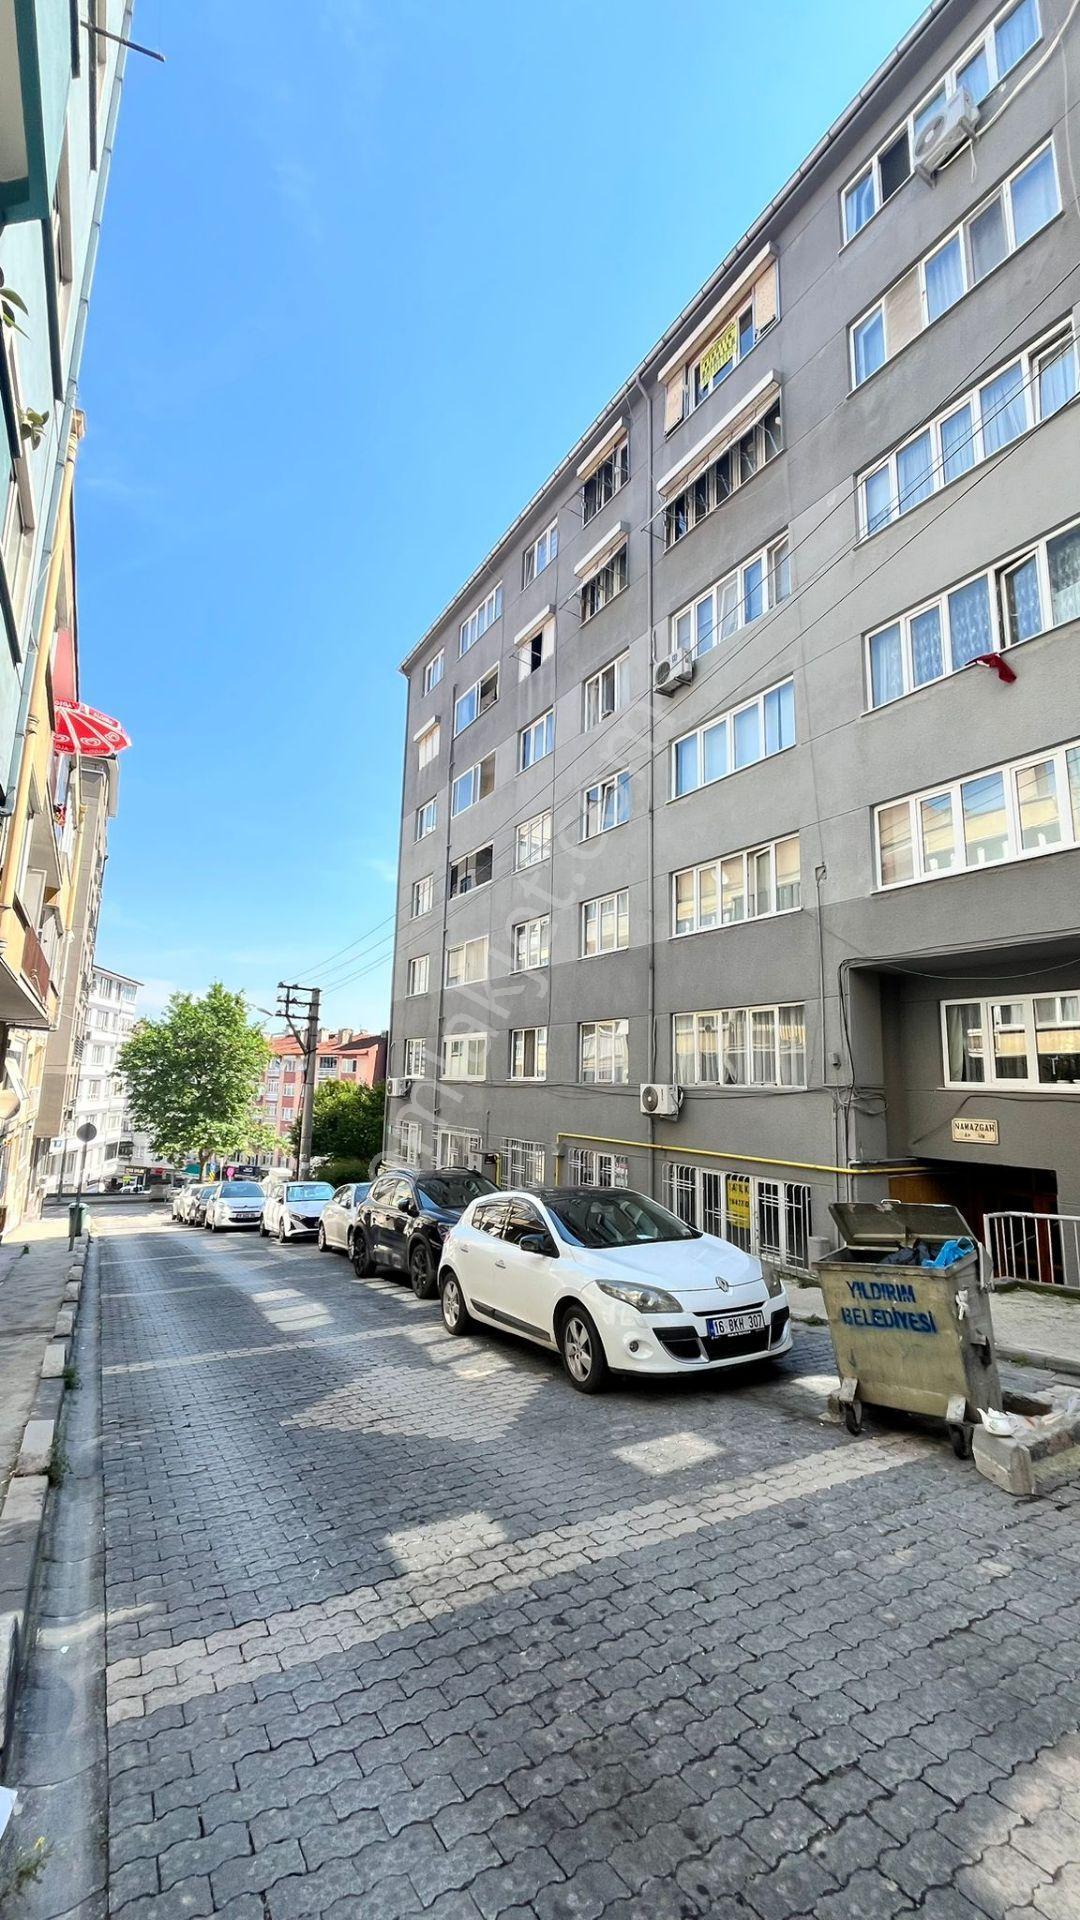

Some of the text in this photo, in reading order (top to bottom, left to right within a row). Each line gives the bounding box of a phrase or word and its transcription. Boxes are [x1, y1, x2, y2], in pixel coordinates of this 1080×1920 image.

[846, 1281, 917, 1303] YILDIRIM
[715, 1320, 725, 1335] 16
[728, 1317, 745, 1331] BKH
[748, 1314, 762, 1328] 307
[841, 1306, 938, 1333] BELEDİYESİ
